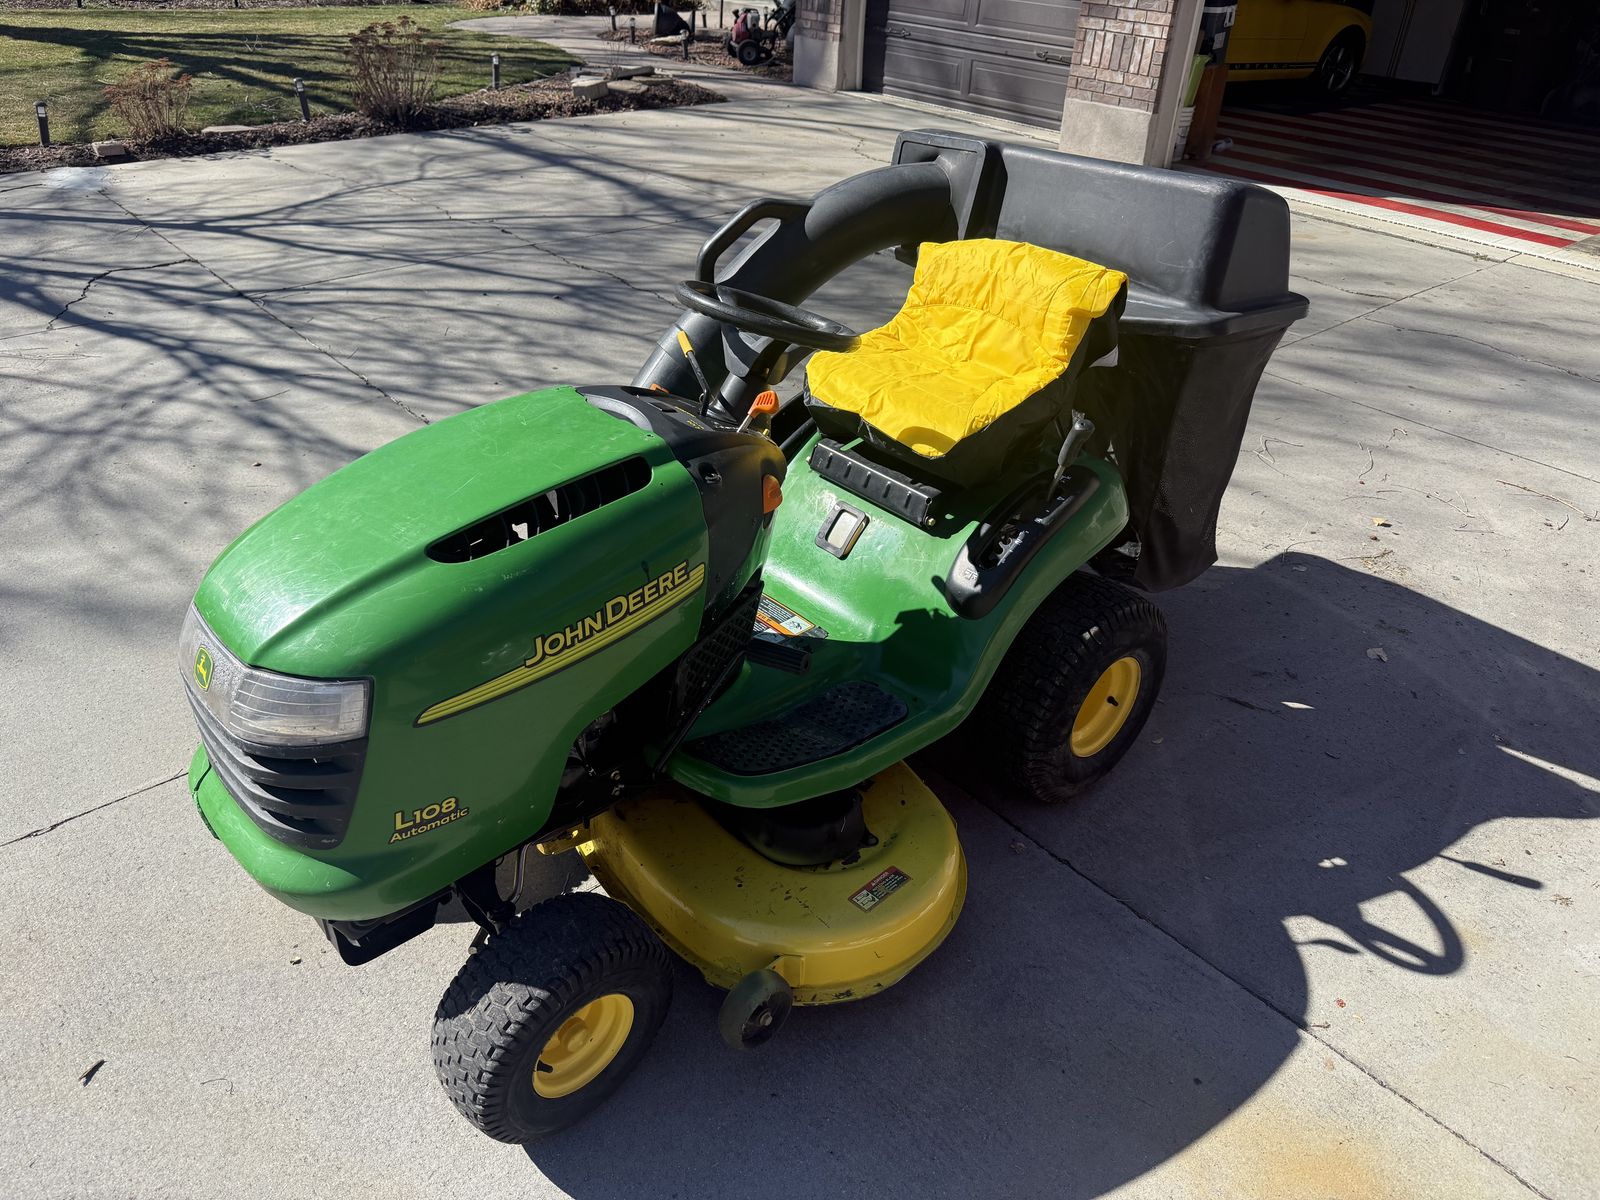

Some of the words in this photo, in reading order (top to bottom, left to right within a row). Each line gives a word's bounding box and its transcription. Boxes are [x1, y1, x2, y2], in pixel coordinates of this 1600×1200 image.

[525, 610, 603, 667] JOHN
[606, 561, 689, 626] DEERE
[389, 808, 468, 843] Automatic
[395, 797, 457, 831] L108
